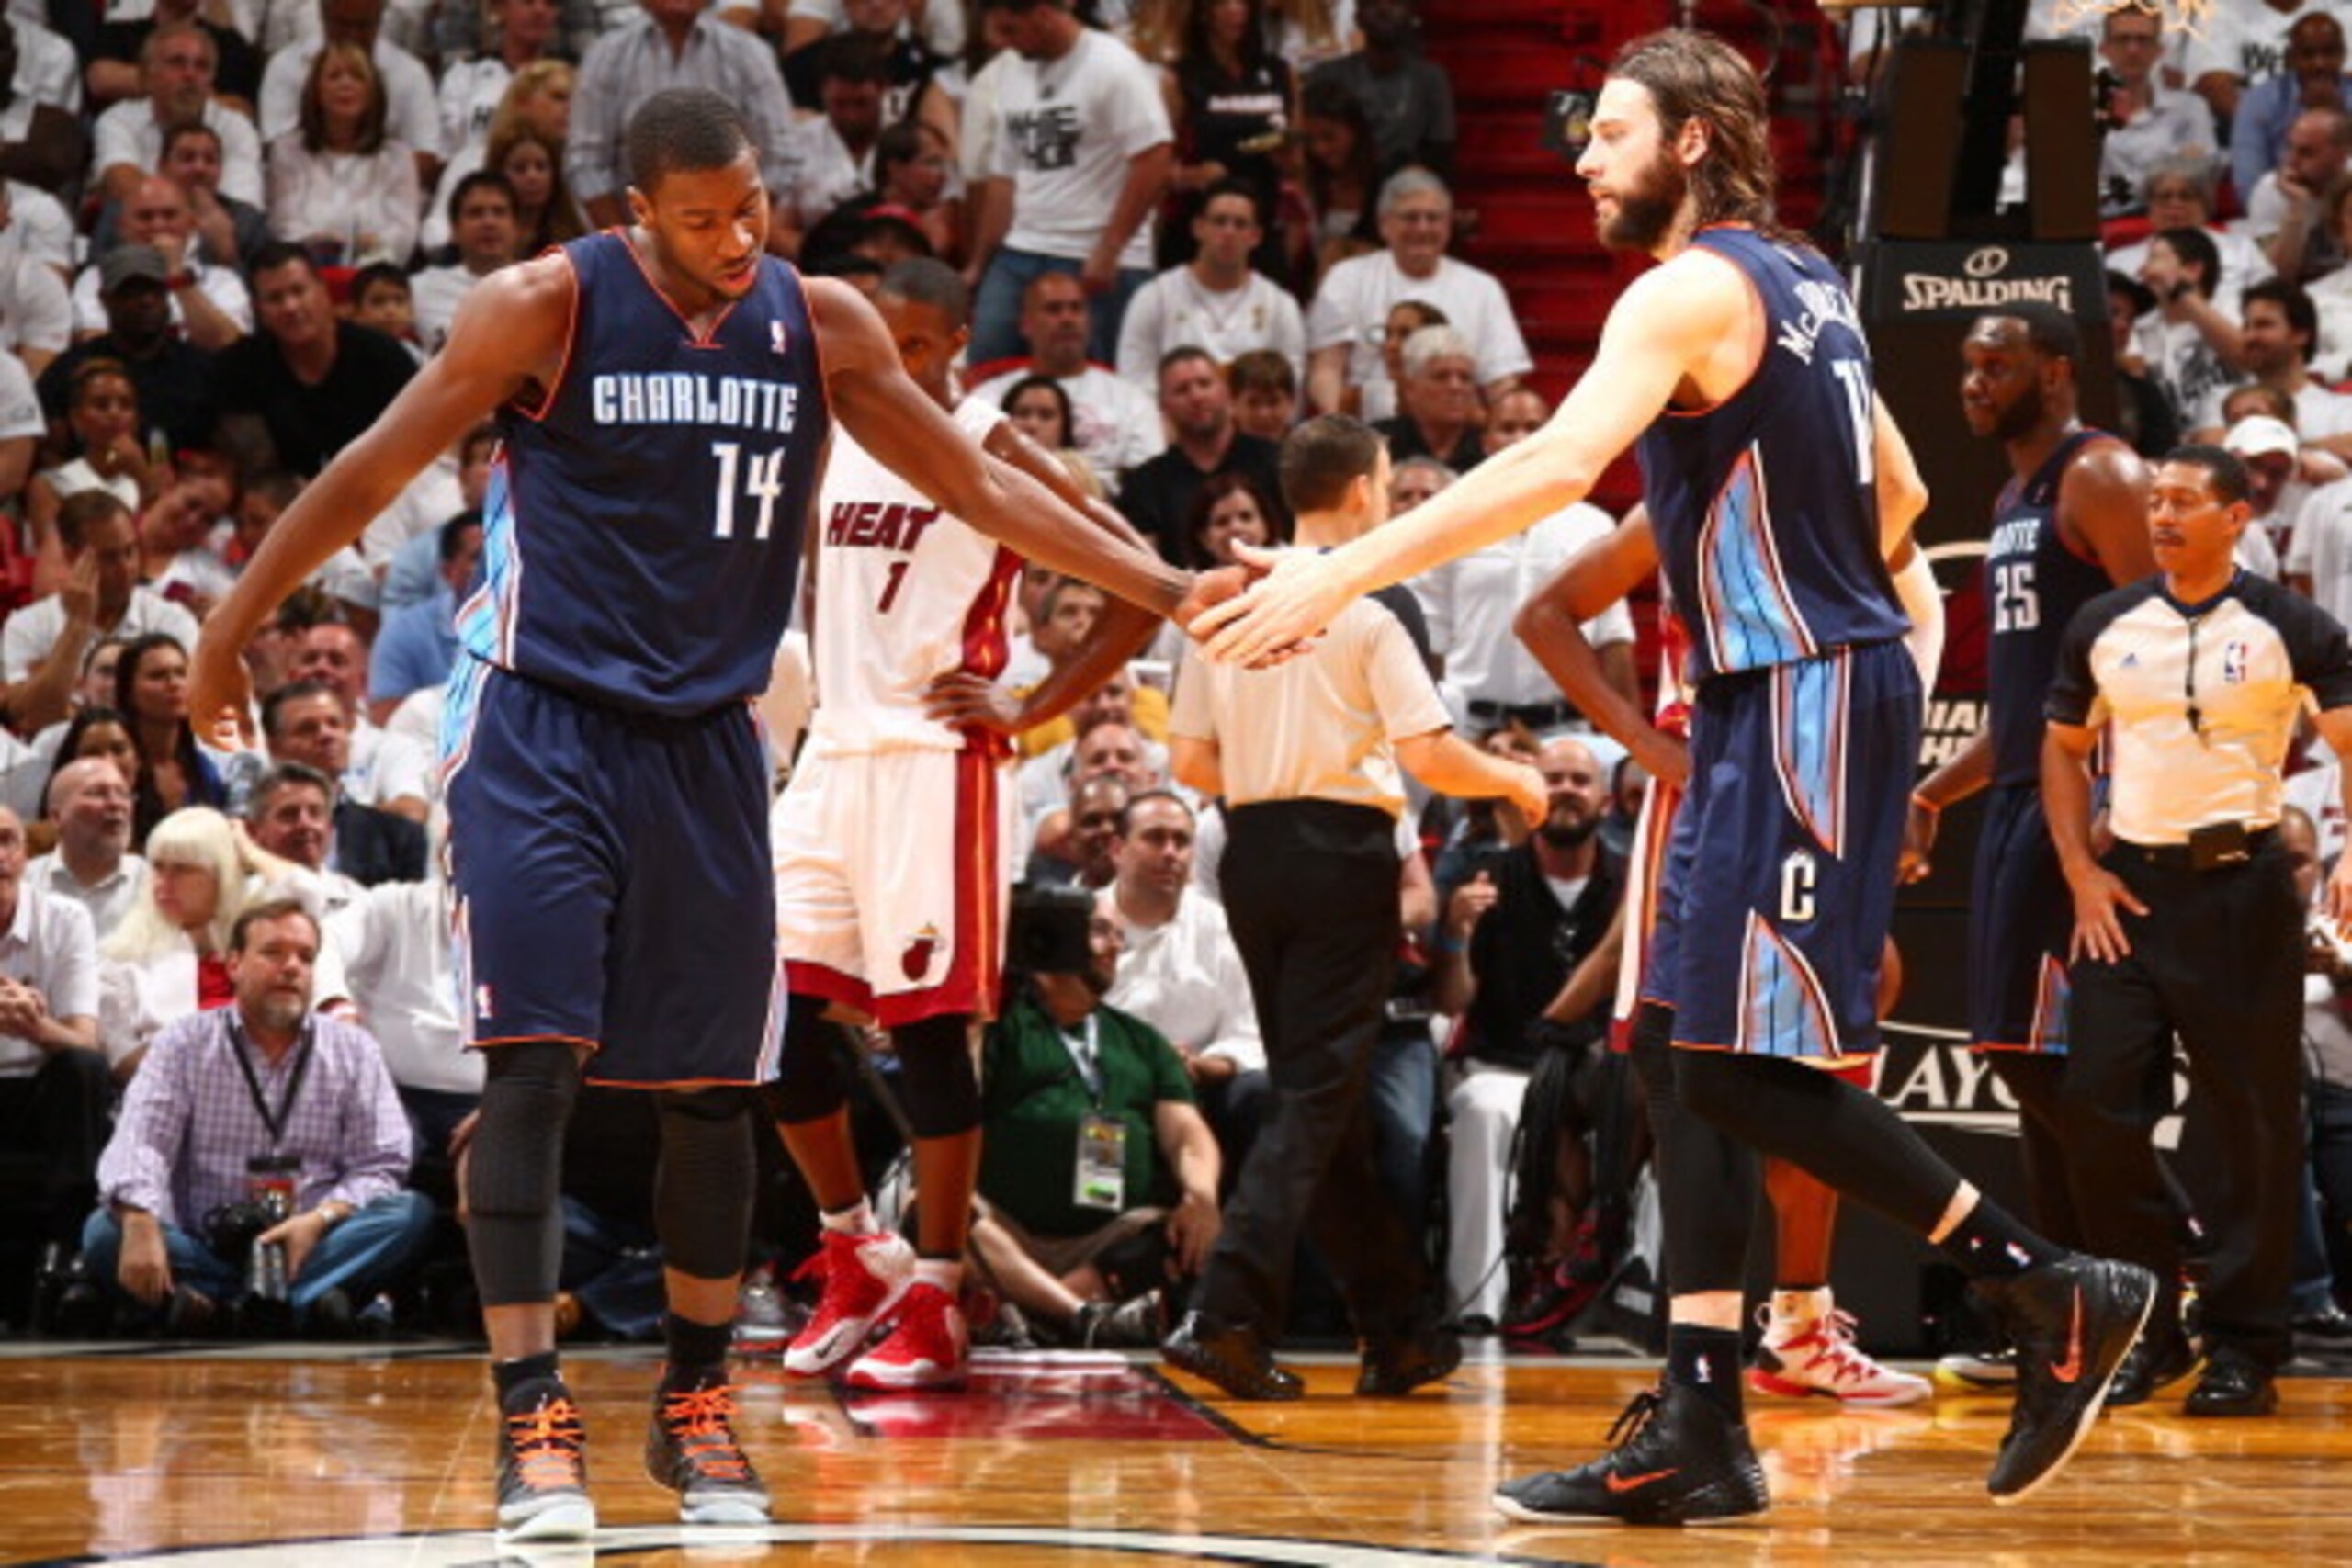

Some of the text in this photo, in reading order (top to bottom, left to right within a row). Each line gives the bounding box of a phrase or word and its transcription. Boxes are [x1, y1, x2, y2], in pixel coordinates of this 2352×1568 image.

[1903, 273, 2074, 313] SPALDING
[593, 373, 798, 433] CHARLOTTE
[711, 442, 786, 540] 14
[828, 502, 942, 552] HEAT
[878, 561, 910, 614] 1
[1995, 562, 2040, 633] 25
[1781, 851, 1815, 921] C
